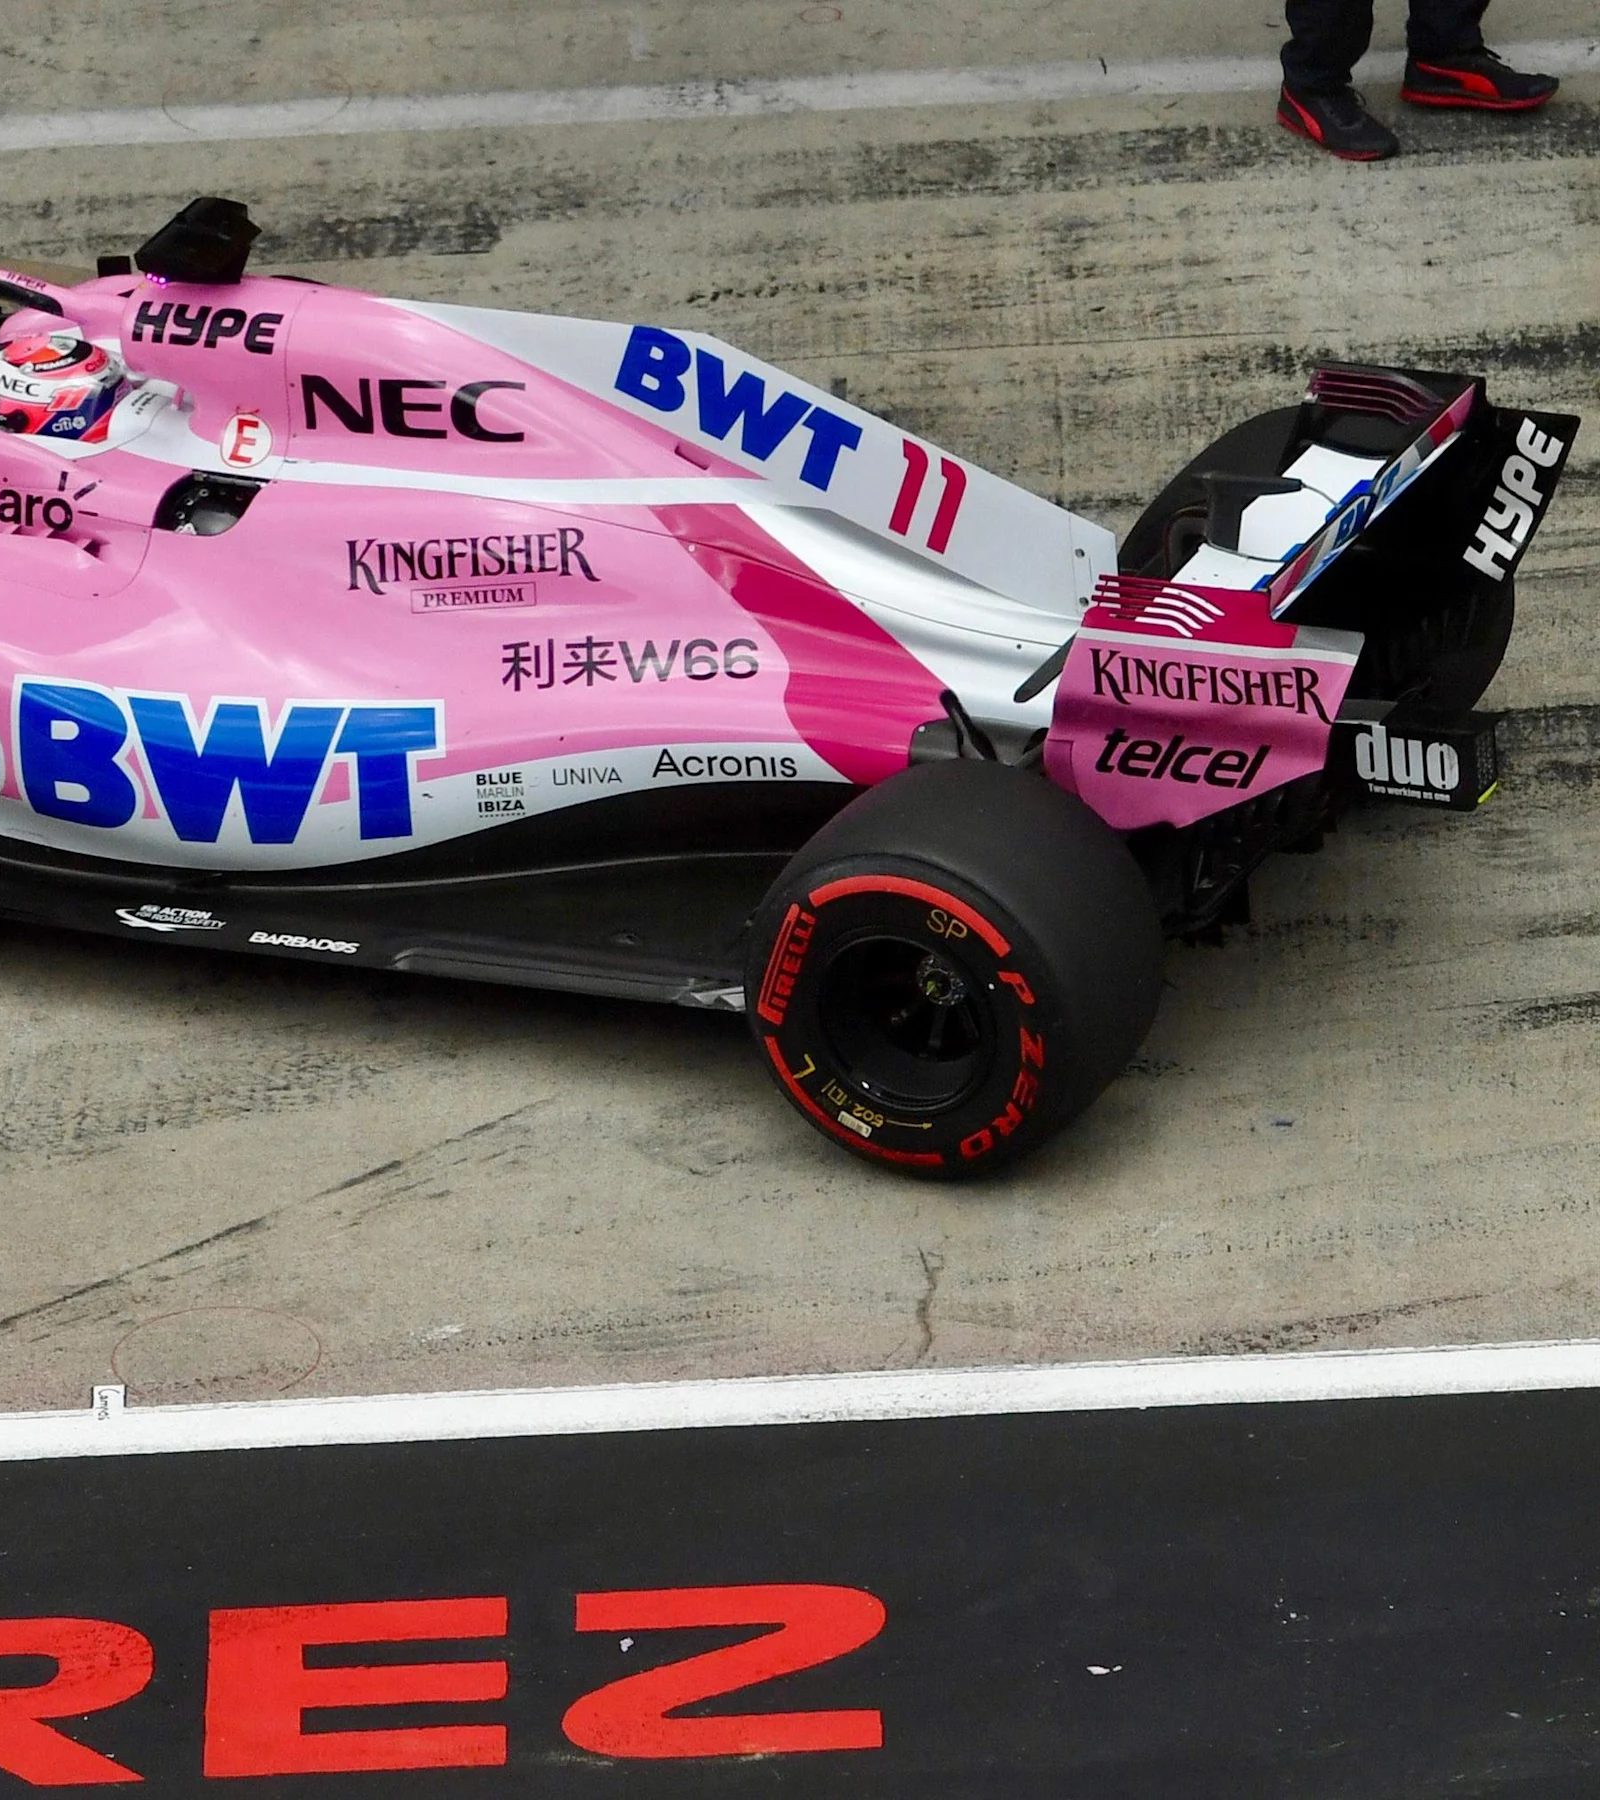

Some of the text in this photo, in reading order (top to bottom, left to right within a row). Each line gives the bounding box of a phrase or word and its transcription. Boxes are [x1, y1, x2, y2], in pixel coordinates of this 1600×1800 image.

[131, 301, 284, 355] HYPE
[0, 374, 41, 397] NEC
[46, 386, 91, 411] 11
[51, 416, 74, 433] citi
[301, 374, 526, 442] NEC
[614, 324, 863, 492] BWT
[229, 418, 260, 464] E
[889, 438, 967, 555] 11
[1463, 416, 1565, 582] HYPE
[347, 527, 602, 595] KINGFISHER
[422, 587, 525, 609] PREMIUM
[501, 636, 760, 693] 利来W66
[1088, 648, 1333, 724] KINGFISHER
[18, 682, 437, 845] BWT
[552, 767, 623, 787] UNIVA
[652, 749, 798, 779] Acronis
[1094, 728, 1272, 790] telcel
[1355, 724, 1460, 791] duo
[476, 772, 523, 786] BLUE
[476, 786, 525, 799] MARLIN
[1368, 783, 1387, 794] Two
[1387, 786, 1422, 799] working
[478, 799, 525, 813] IBIZA
[160, 907, 213, 920] ACTION
[184, 918, 227, 929] SAFETY
[926, 908, 968, 941] SP
[249, 931, 361, 954] BARBADOS
[757, 902, 818, 1026] PIRELLI
[959, 970, 1045, 1159] P ZERO
